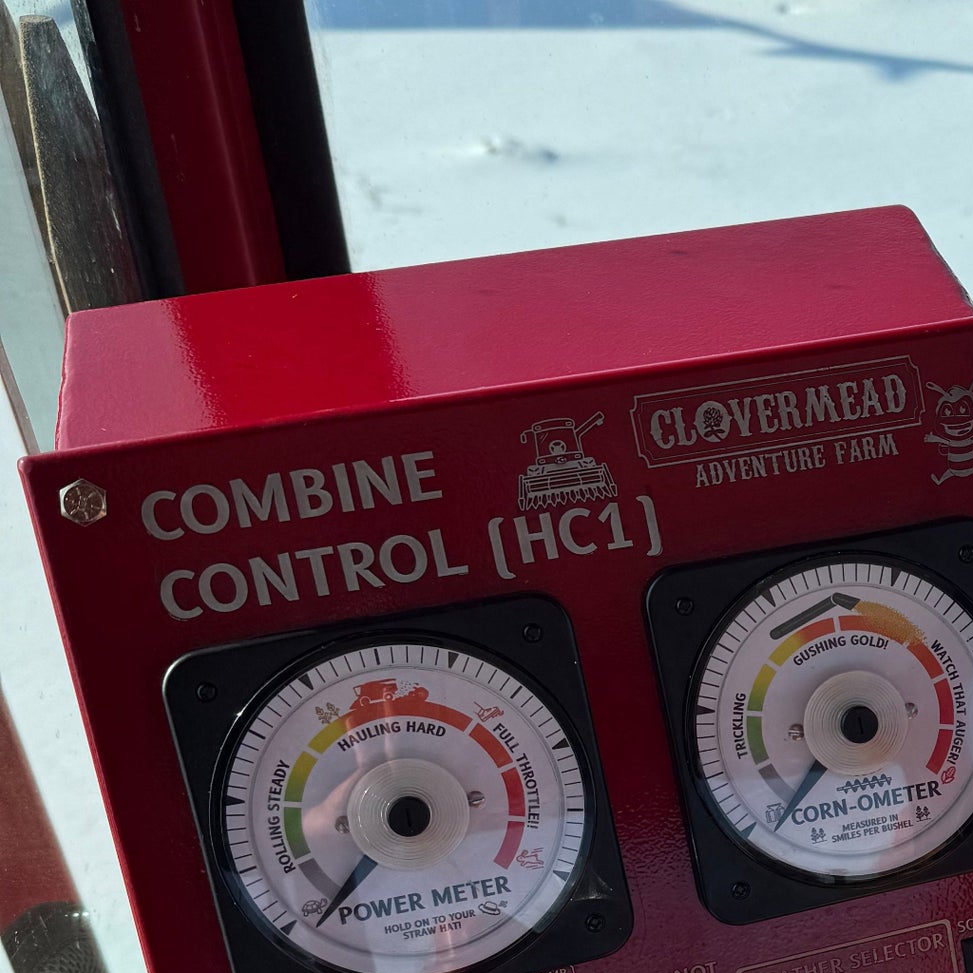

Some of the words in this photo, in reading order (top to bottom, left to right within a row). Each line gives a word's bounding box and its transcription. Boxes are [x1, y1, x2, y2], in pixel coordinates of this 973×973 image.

[695, 445, 826, 487] ADVENTURE
[836, 434, 899, 467] FARM
[141, 451, 443, 541] COMBINE
[160, 529, 469, 621] CONTROL
[793, 636, 847, 666] GUSHING
[850, 634, 889, 650] GOLD!
[930, 640, 960, 681] WATCH
[952, 682, 967, 716] THAT
[337, 721, 401, 751] HAULING
[406, 721, 446, 737] HARD
[732, 693, 748, 759] TRICKLING
[946, 719, 965, 765] AUGER!
[268, 759, 290, 811] STEADY
[493, 722, 519, 754] FULL
[517, 754, 541, 829] THROTTLE!!
[791, 780, 942, 826] CORN-OMETER
[842, 816, 887, 832] MEASURED
[889, 814, 899, 823] IN
[267, 812, 296, 874] ROLLING
[831, 829, 861, 843] SMILES
[864, 826, 880, 838] PER
[881, 820, 914, 835] BUSHEL
[339, 894, 425, 924] POWER
[431, 876, 511, 908] METER
[384, 921, 412, 934] HOLD
[414, 919, 431, 930] ON
[433, 916, 446, 927] TO
[448, 909, 476, 924] YOUR
[403, 926, 438, 940] STRAW
[440, 921, 462, 934] HAT!
[850, 933, 945, 969] SELECTOR
